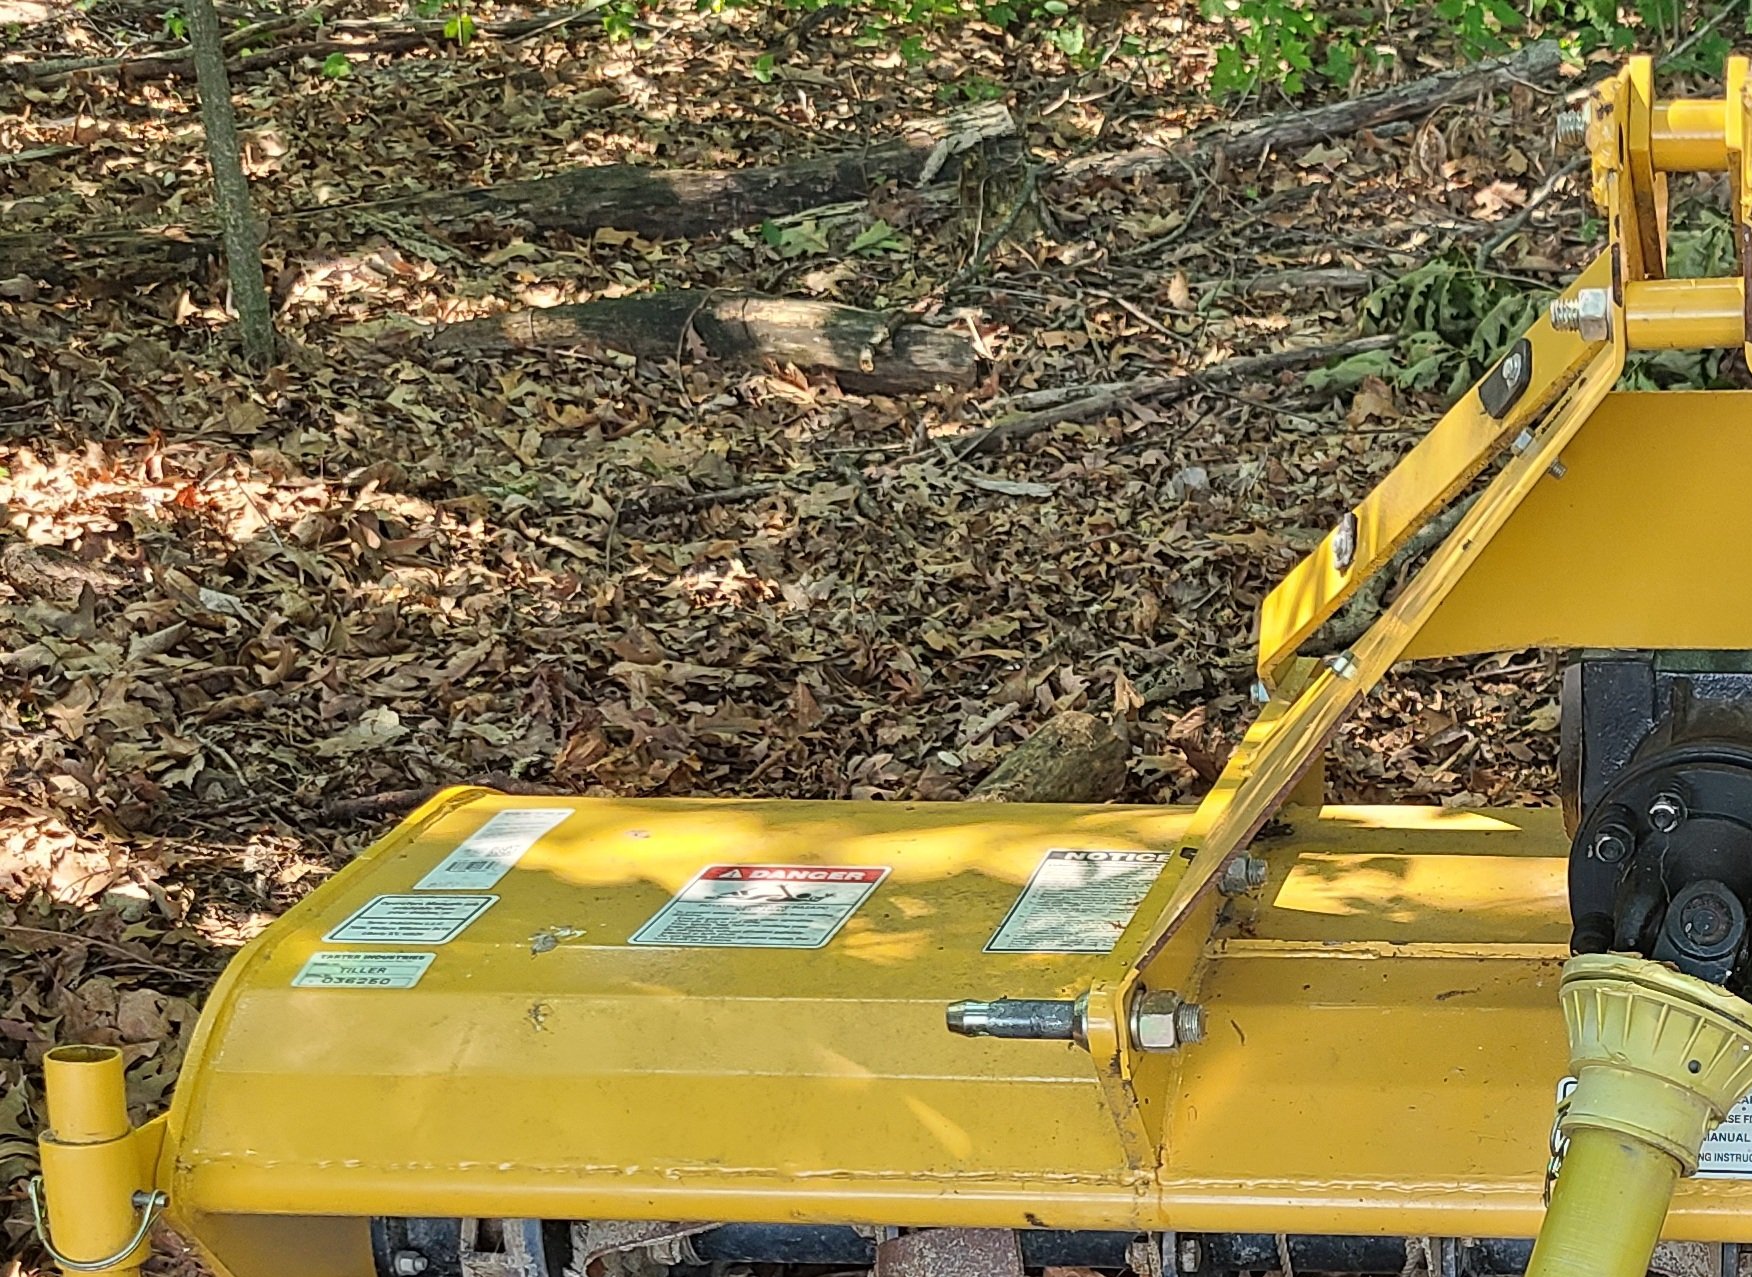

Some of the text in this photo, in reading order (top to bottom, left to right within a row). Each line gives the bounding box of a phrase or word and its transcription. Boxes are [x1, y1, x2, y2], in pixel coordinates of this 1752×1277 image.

[750, 869, 866, 881] DANGER
[1726, 1114, 1742, 1124] SE
[1697, 1152, 1712, 1162] NG
